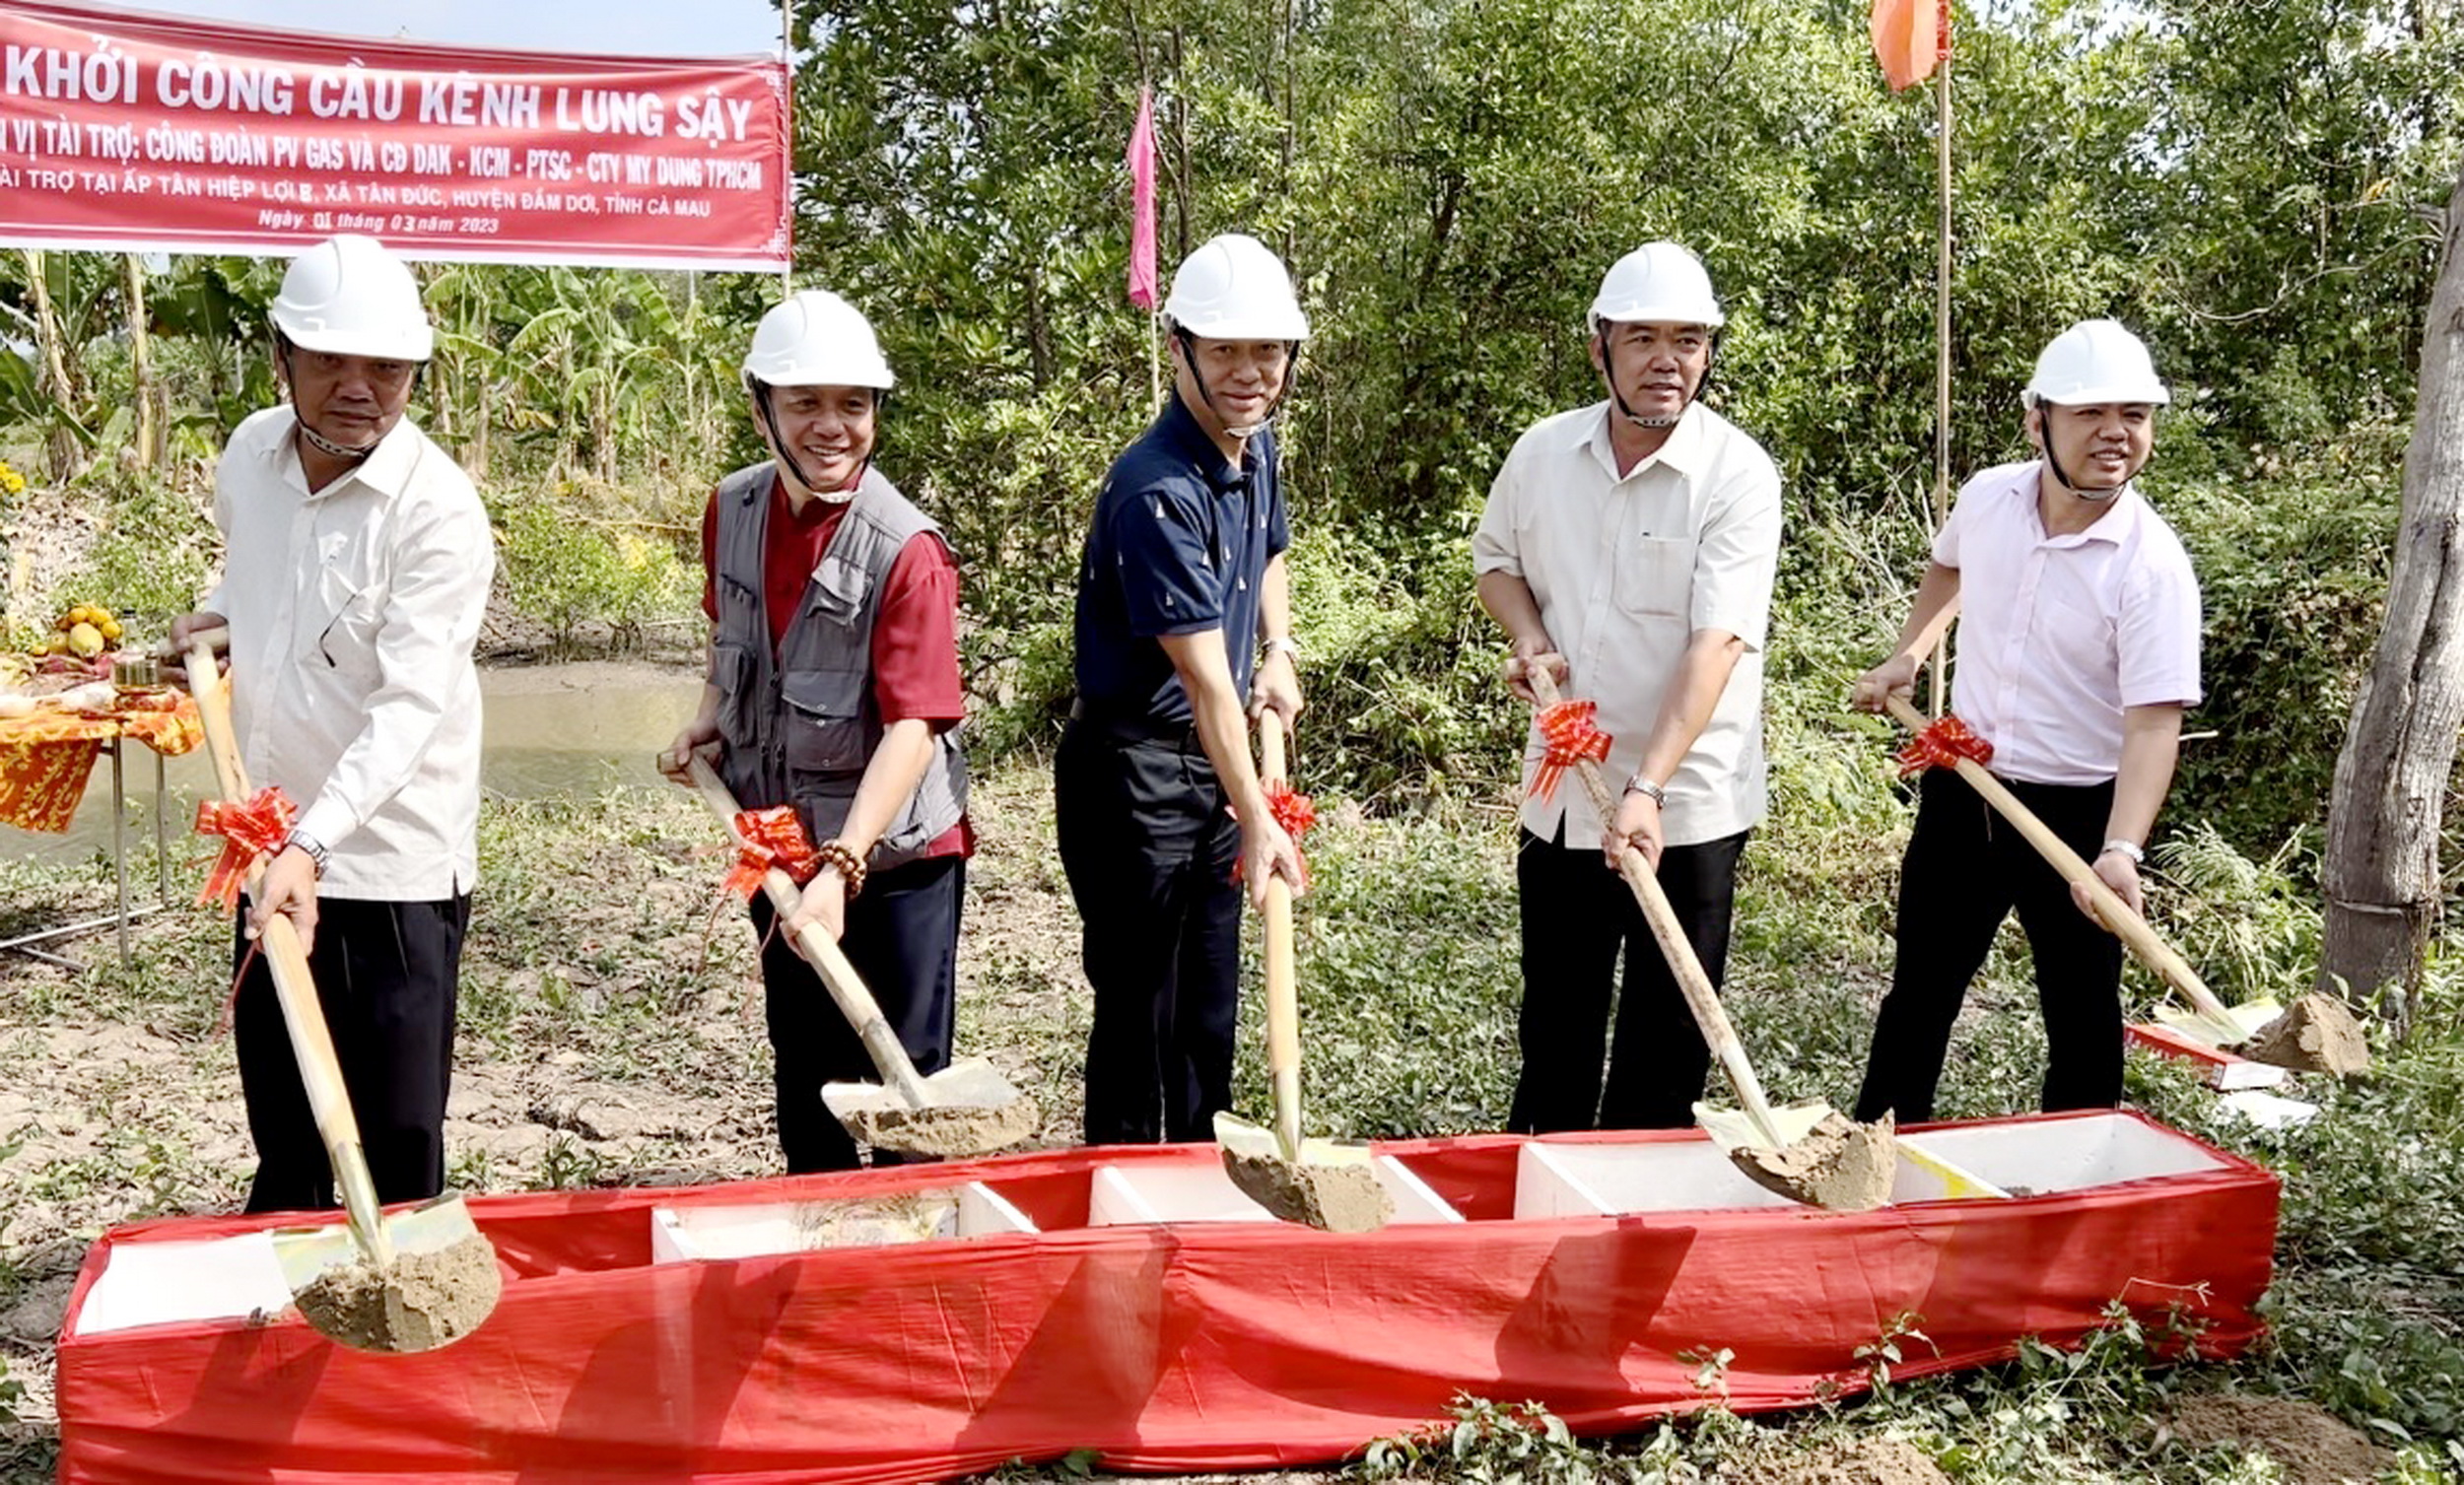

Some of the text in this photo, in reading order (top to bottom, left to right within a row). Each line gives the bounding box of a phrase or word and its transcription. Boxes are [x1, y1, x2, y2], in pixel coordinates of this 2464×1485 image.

[6, 34, 752, 149] KHỞI CÔNG CẦU KÊNH LUNG SẬY
[13, 119, 36, 162] VỊ
[42, 113, 80, 156] TÀI
[86, 122, 140, 166] TRỢ:
[146, 119, 204, 163] CÔNG
[209, 124, 267, 167] ĐOÀN
[273, 136, 298, 168] PV
[306, 137, 344, 170] GAS
[349, 131, 376, 171] VÀ
[380, 141, 407, 172] CĐ
[413, 144, 451, 175] DAK
[469, 147, 511, 177] KCM
[526, 150, 572, 180] PTSC
[586, 152, 619, 183] CTY
[656, 157, 702, 187] DUNG
[705, 159, 762, 189] TPHCM
[27, 169, 74, 193] TRỢ
[81, 171, 117, 195] TẠI
[122, 168, 151, 193] ẤP
[157, 171, 201, 195] TÂN
[207, 174, 255, 201] HIỆP
[261, 179, 296, 203] LỢI
[324, 179, 351, 202] XÃ
[356, 181, 396, 204] TÂN
[453, 186, 515, 211] HUYỆN
[648, 195, 669, 215] CÀ
[673, 199, 711, 217] MAU
[258, 209, 304, 230] Ngày
[337, 213, 385, 232] tháng
[417, 216, 454, 232] năm
[458, 217, 500, 233] 2023
